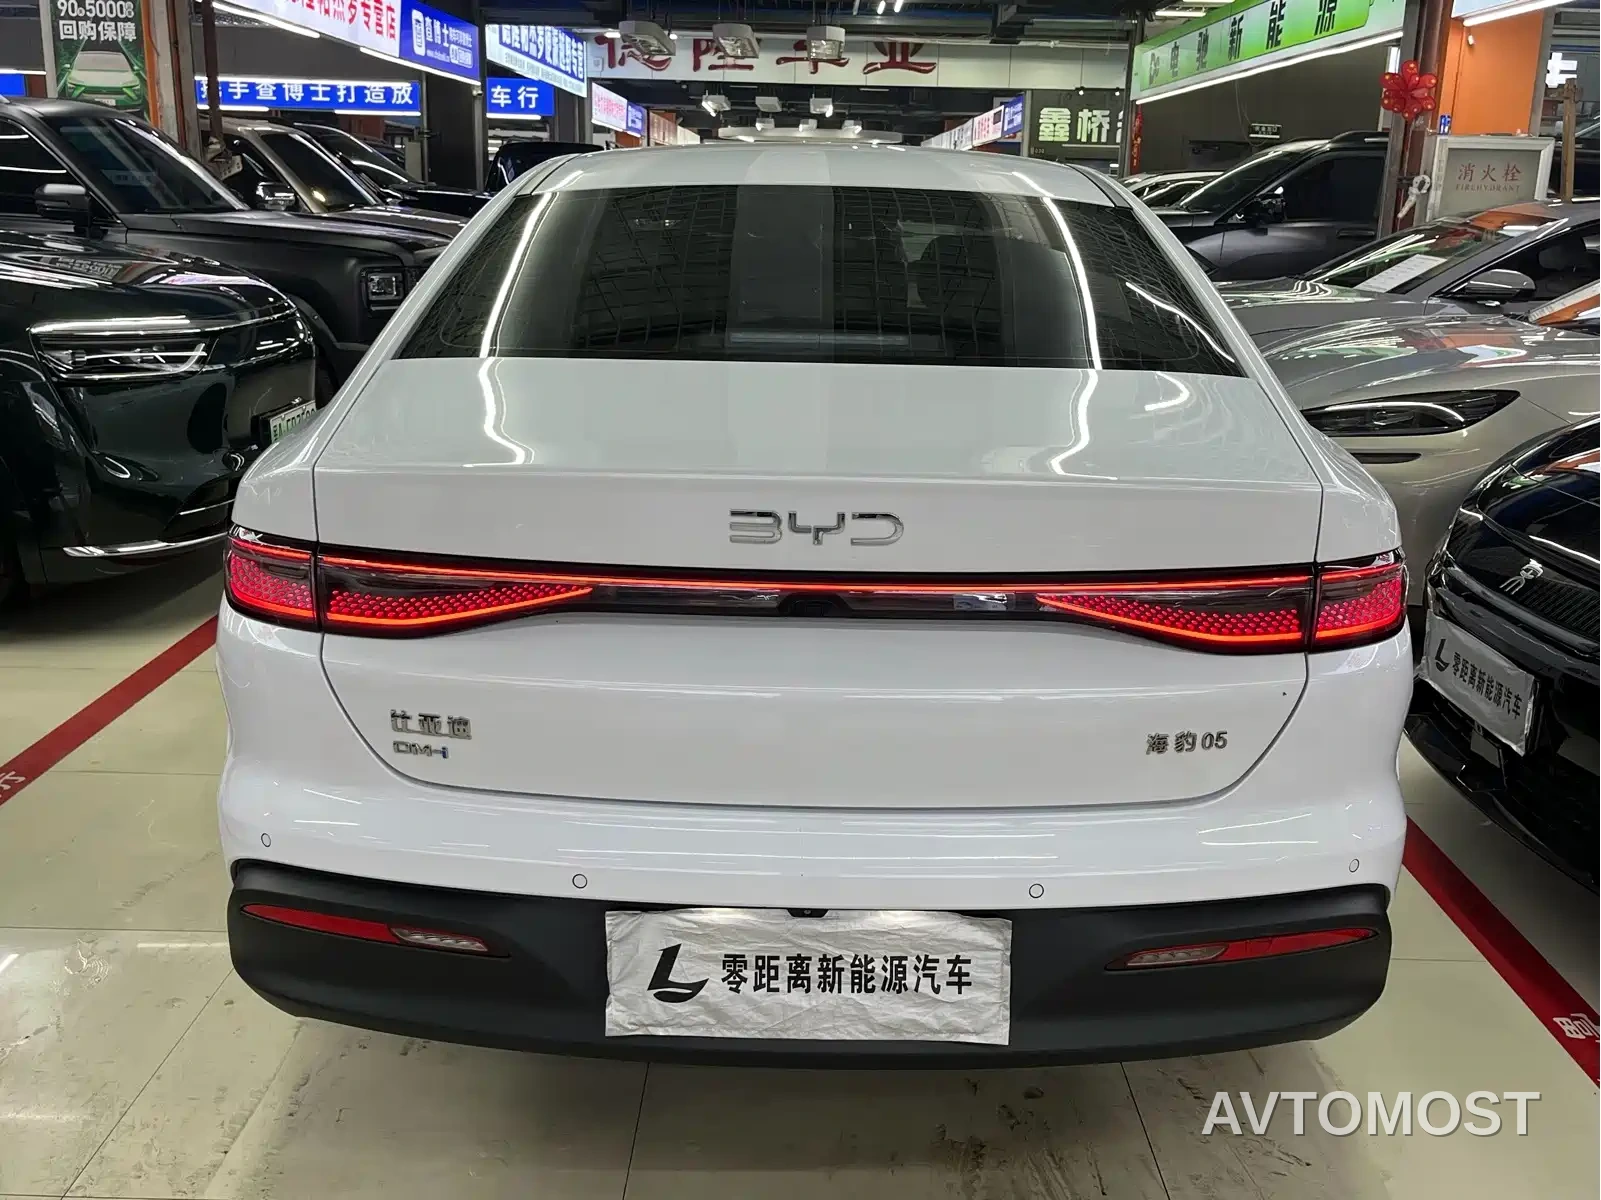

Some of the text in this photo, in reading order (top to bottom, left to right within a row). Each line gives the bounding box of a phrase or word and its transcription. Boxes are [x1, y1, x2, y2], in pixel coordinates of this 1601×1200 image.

[58, 20, 137, 41] 回购保障
[490, 85, 540, 109] 车行
[1458, 162, 1522, 182] 消火栓
[729, 508, 904, 546] BYD
[1453, 651, 1524, 720] 零距离新能源汽车
[390, 709, 472, 740] 比亚迪
[721, 952, 973, 995] 零距离新能源汽车
